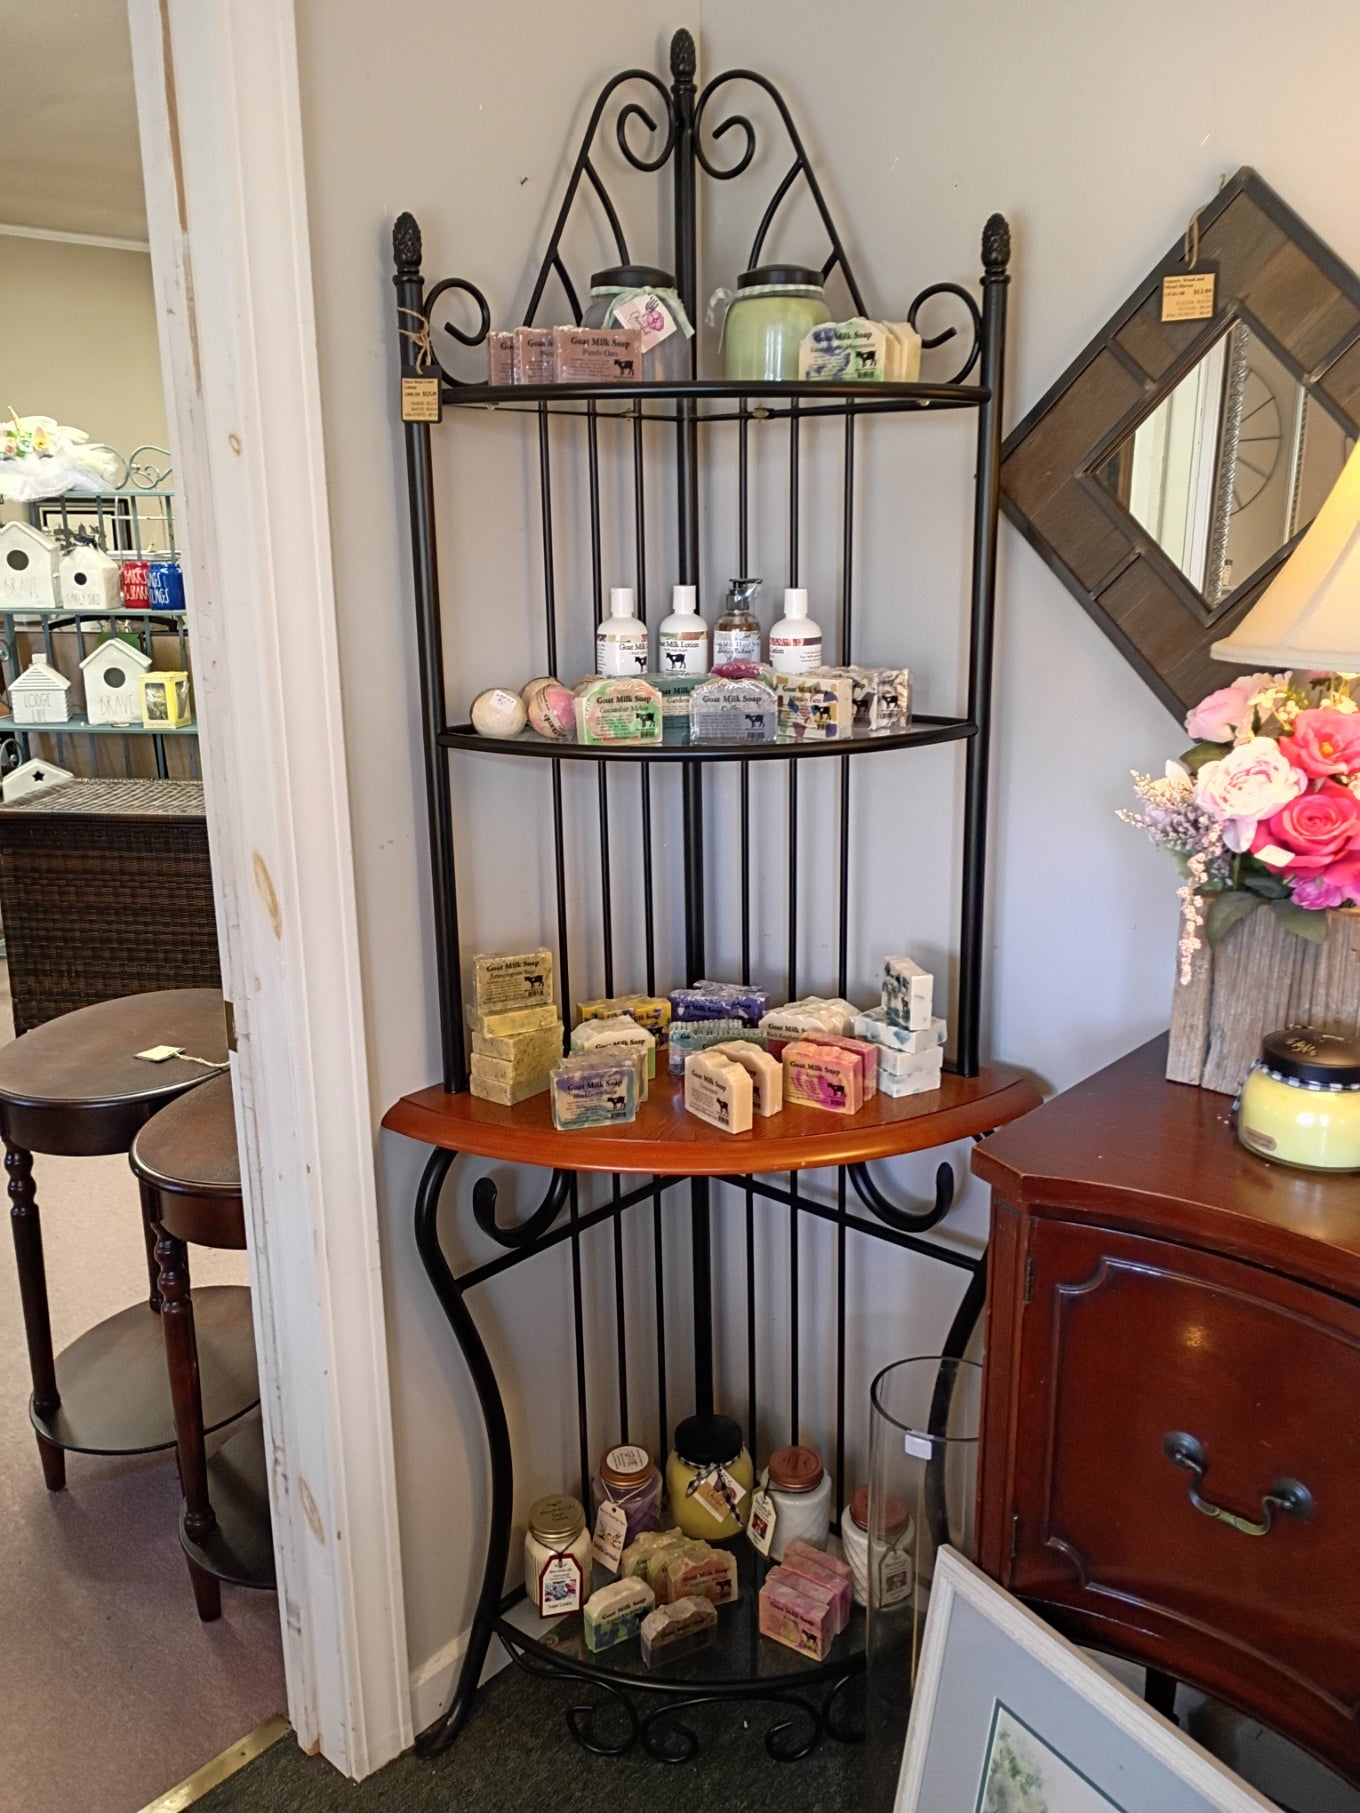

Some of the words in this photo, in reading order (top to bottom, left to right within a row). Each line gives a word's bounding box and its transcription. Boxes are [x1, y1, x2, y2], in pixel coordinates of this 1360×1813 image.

[854, 331, 873, 340] Soap
[570, 336, 588, 346] Goat
[591, 337, 609, 347] Milk
[612, 339, 631, 350] Soap
[596, 696, 614, 704] Goat
[616, 695, 633, 704] Milk
[634, 695, 651, 703] Soap
[702, 695, 721, 703] Goat
[723, 694, 742, 703] Milk
[743, 695, 762, 704] Soap
[505, 961, 521, 970] Milk
[523, 960, 540, 968] Soap
[768, 1023, 783, 1031] Goat
[785, 1025, 799, 1034] Milk
[790, 1060, 806, 1069] Goat
[807, 1063, 823, 1072] Milk
[824, 1066, 841, 1076] Soap
[568, 1083, 585, 1091] Goat
[587, 1081, 604, 1089] Milk
[605, 1079, 623, 1088] Soap
